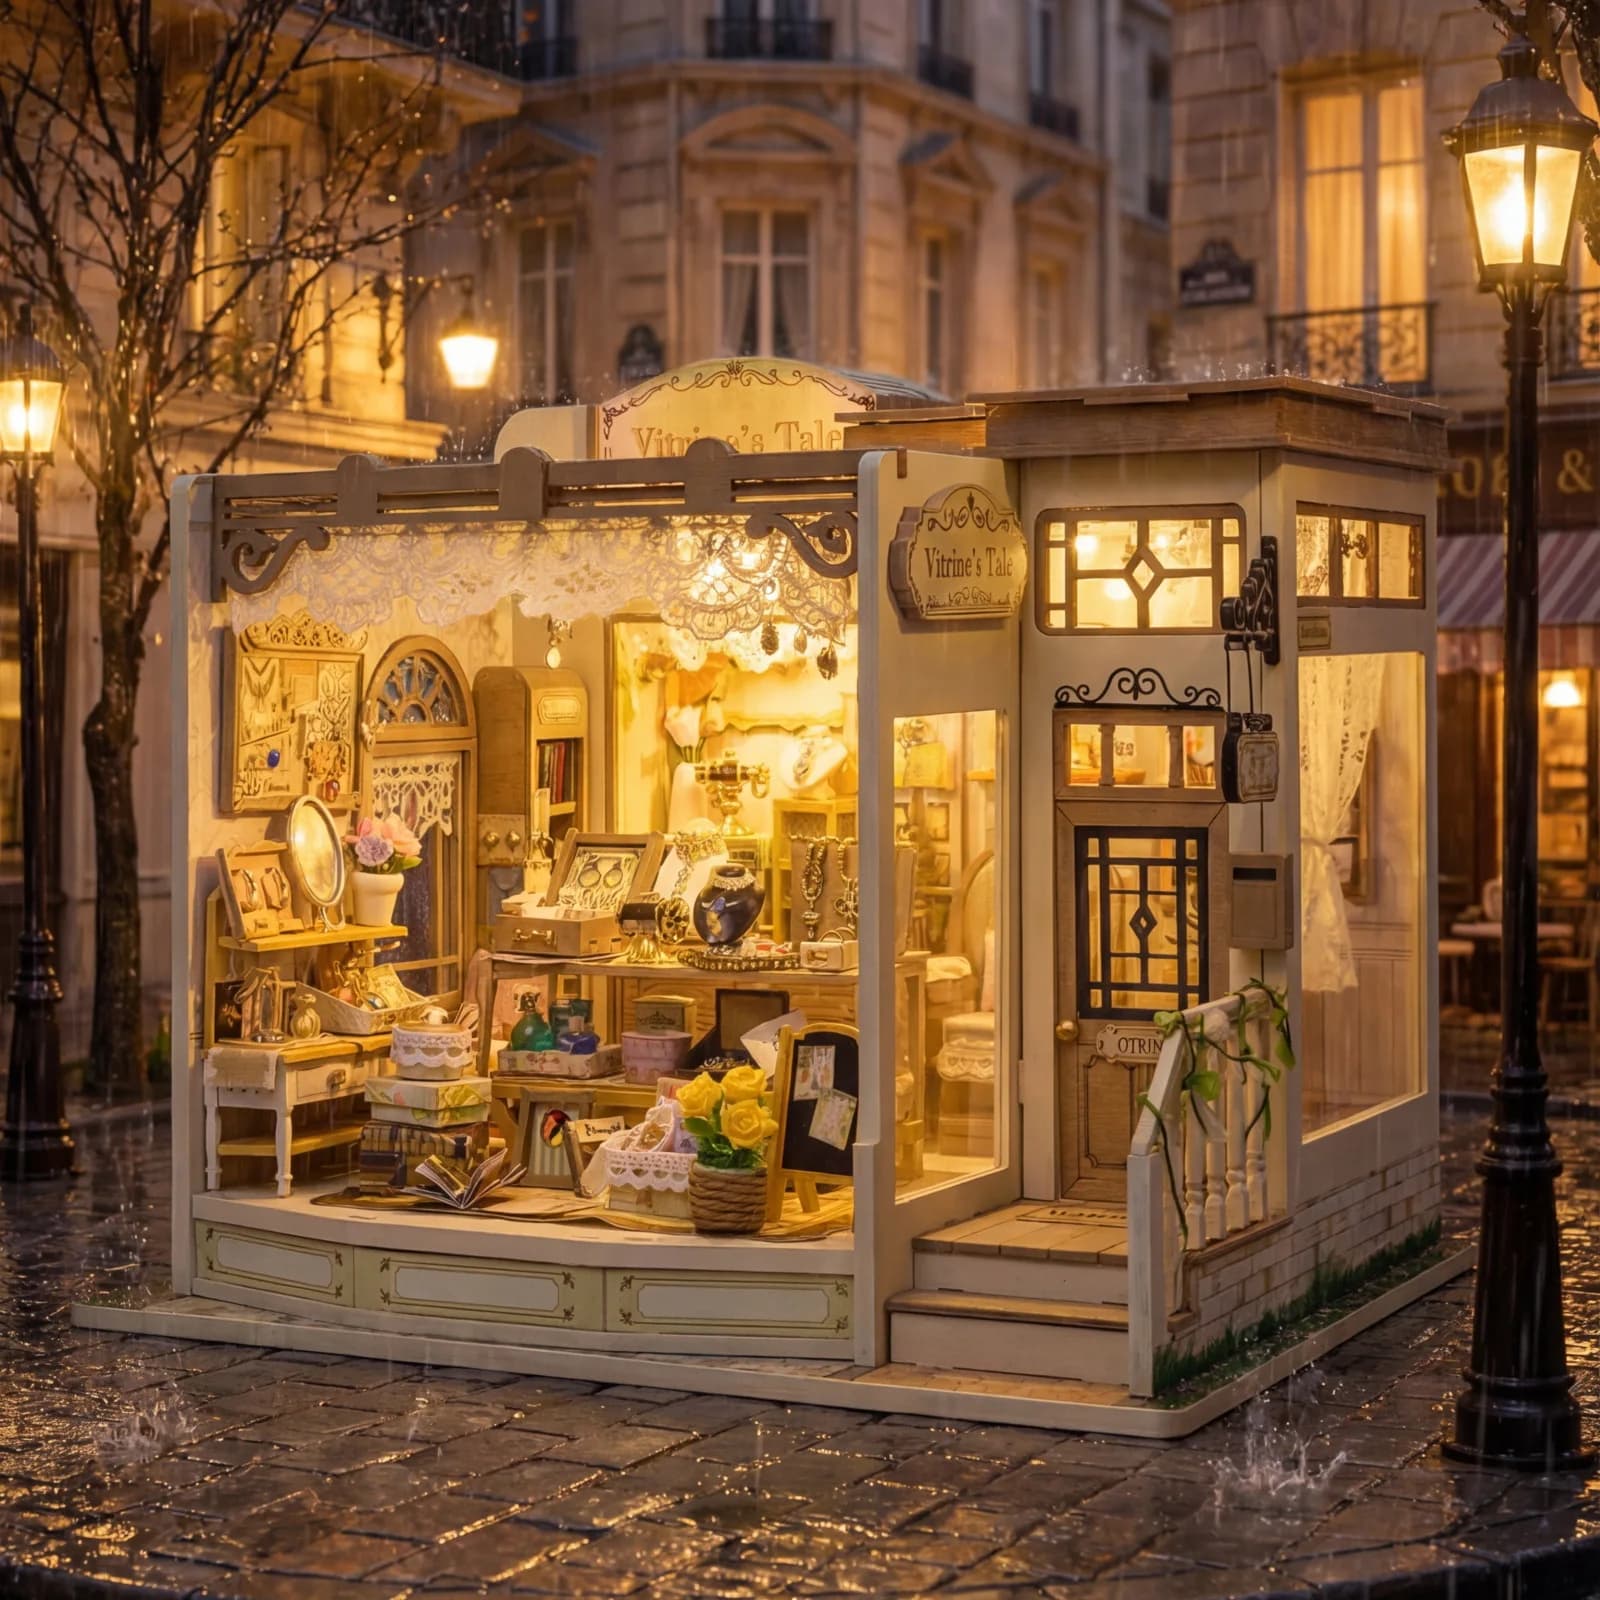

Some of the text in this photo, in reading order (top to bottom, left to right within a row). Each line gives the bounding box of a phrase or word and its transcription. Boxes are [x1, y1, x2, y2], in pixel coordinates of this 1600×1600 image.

[774, 419, 842, 451] Tale
[924, 546, 1013, 578] Vitrine's Tale
